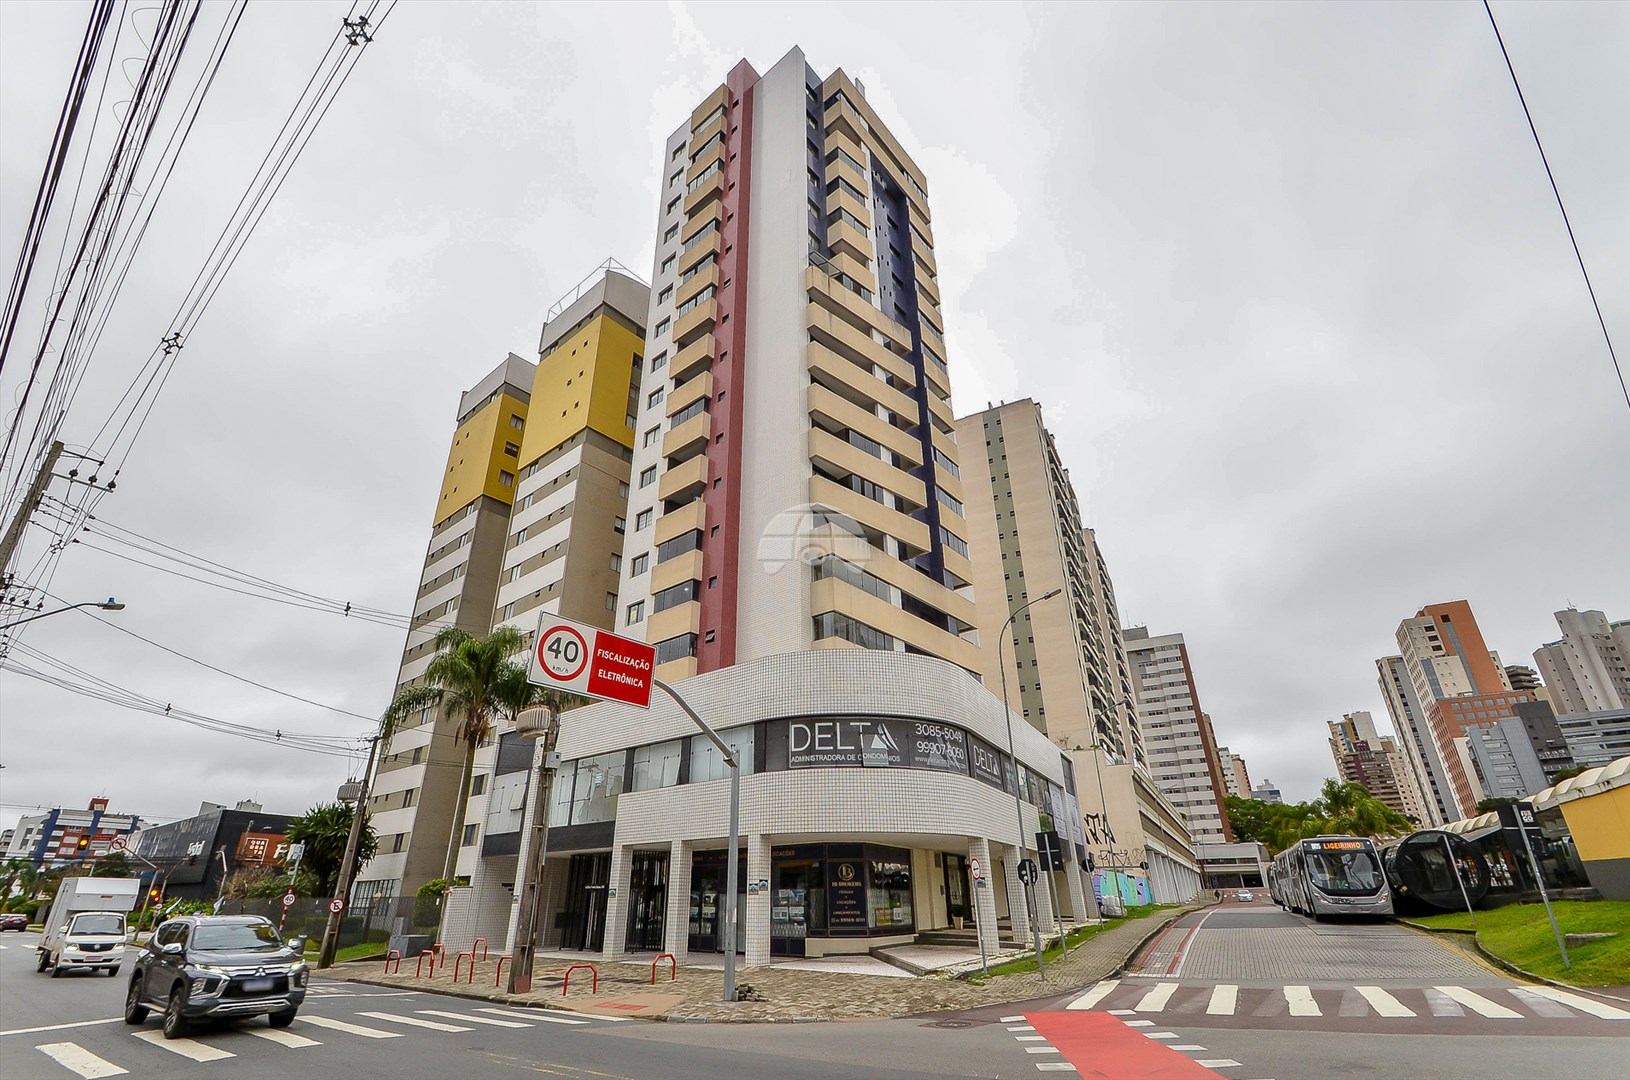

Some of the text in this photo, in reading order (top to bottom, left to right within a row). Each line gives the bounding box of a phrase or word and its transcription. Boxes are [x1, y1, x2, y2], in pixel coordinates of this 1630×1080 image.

[547, 636, 579, 663] 40
[597, 648, 650, 671] FISCALIZAÇÃO
[552, 665, 569, 674] km/h
[598, 668, 643, 689] ELETRÔNICA
[915, 723, 963, 742] 3085-5049
[791, 753, 846, 763] ADMINISTRADORA
[847, 753, 856, 761] DE
